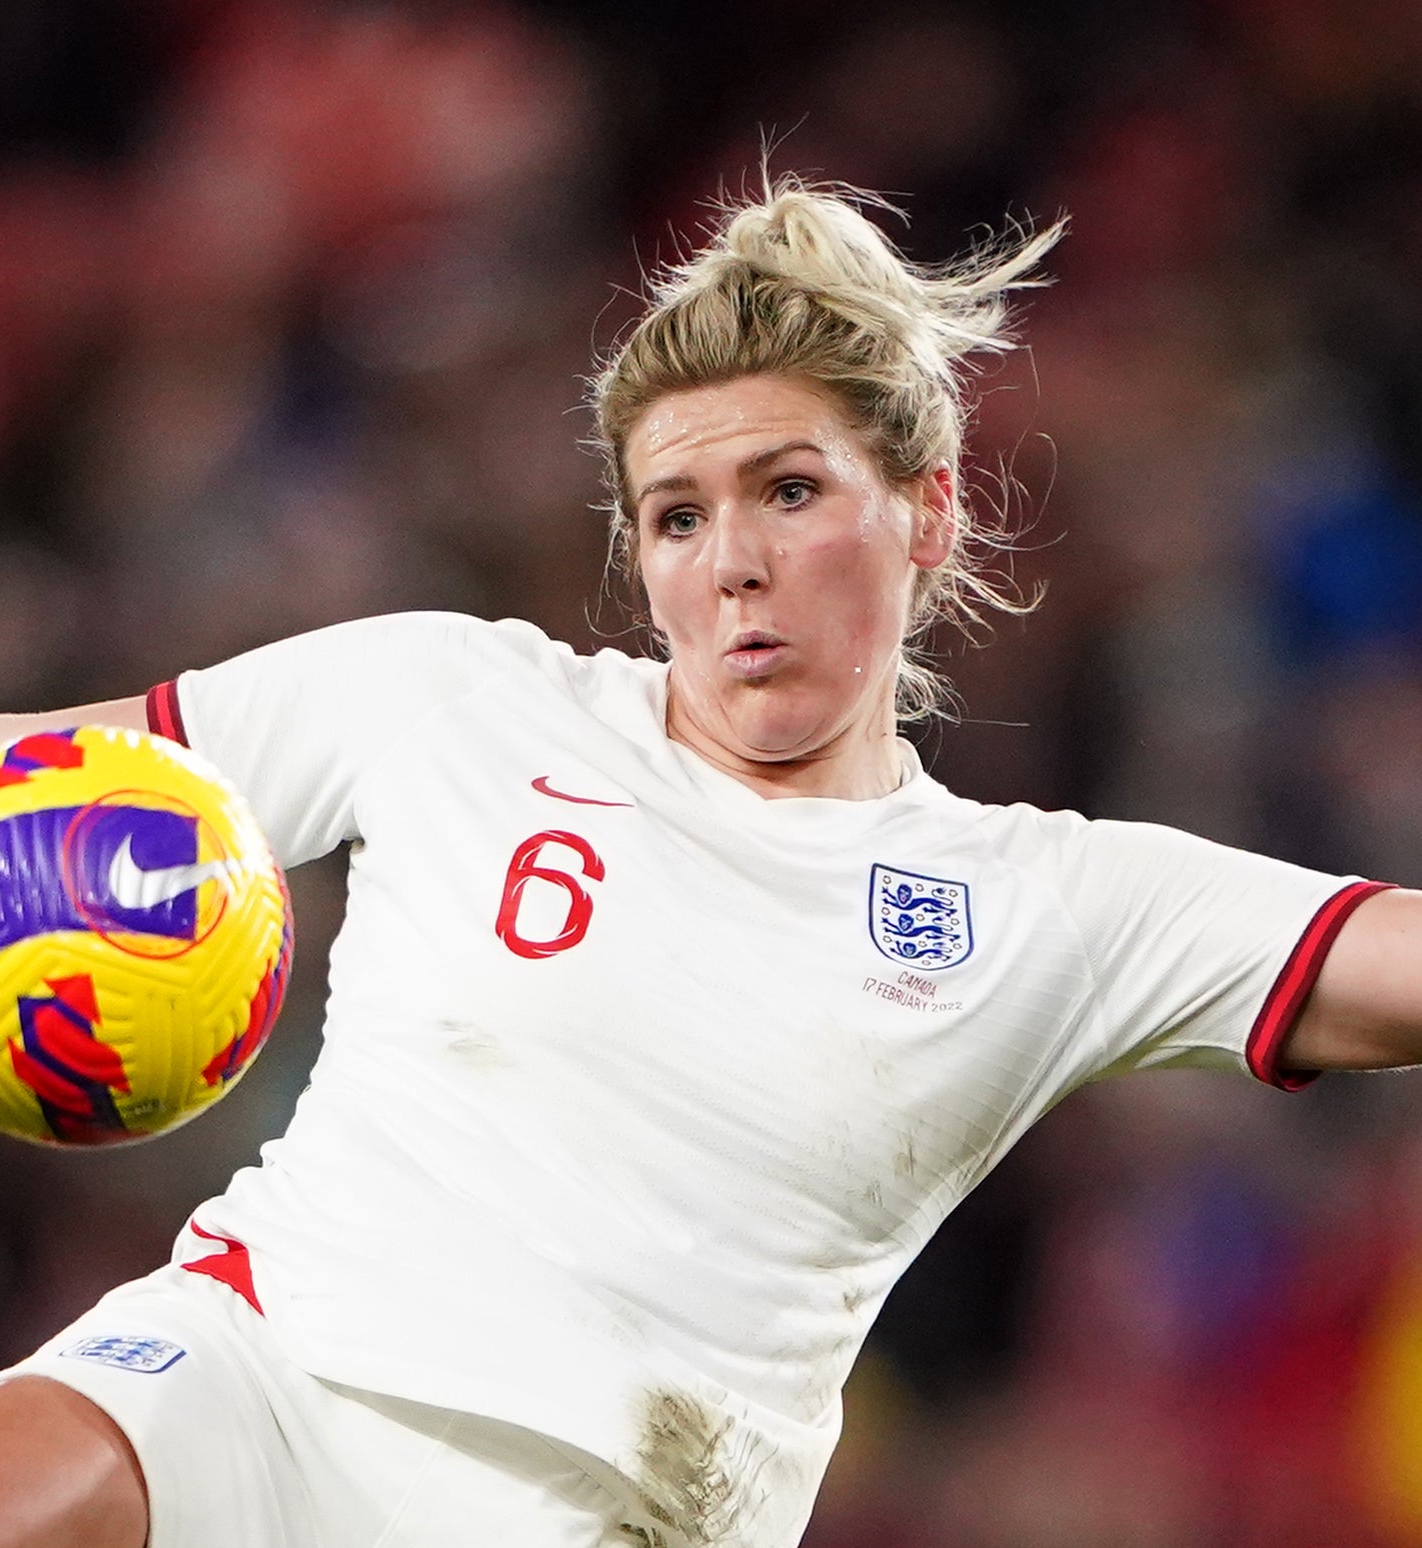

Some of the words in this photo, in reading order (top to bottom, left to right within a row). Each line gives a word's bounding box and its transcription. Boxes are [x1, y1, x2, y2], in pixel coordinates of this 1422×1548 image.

[495, 829, 605, 960] 6
[862, 977, 877, 991] 17
[876, 982, 928, 1011] FEBRUARY
[931, 1001, 962, 1012] 2022
[897, 970, 938, 998] CANADA
